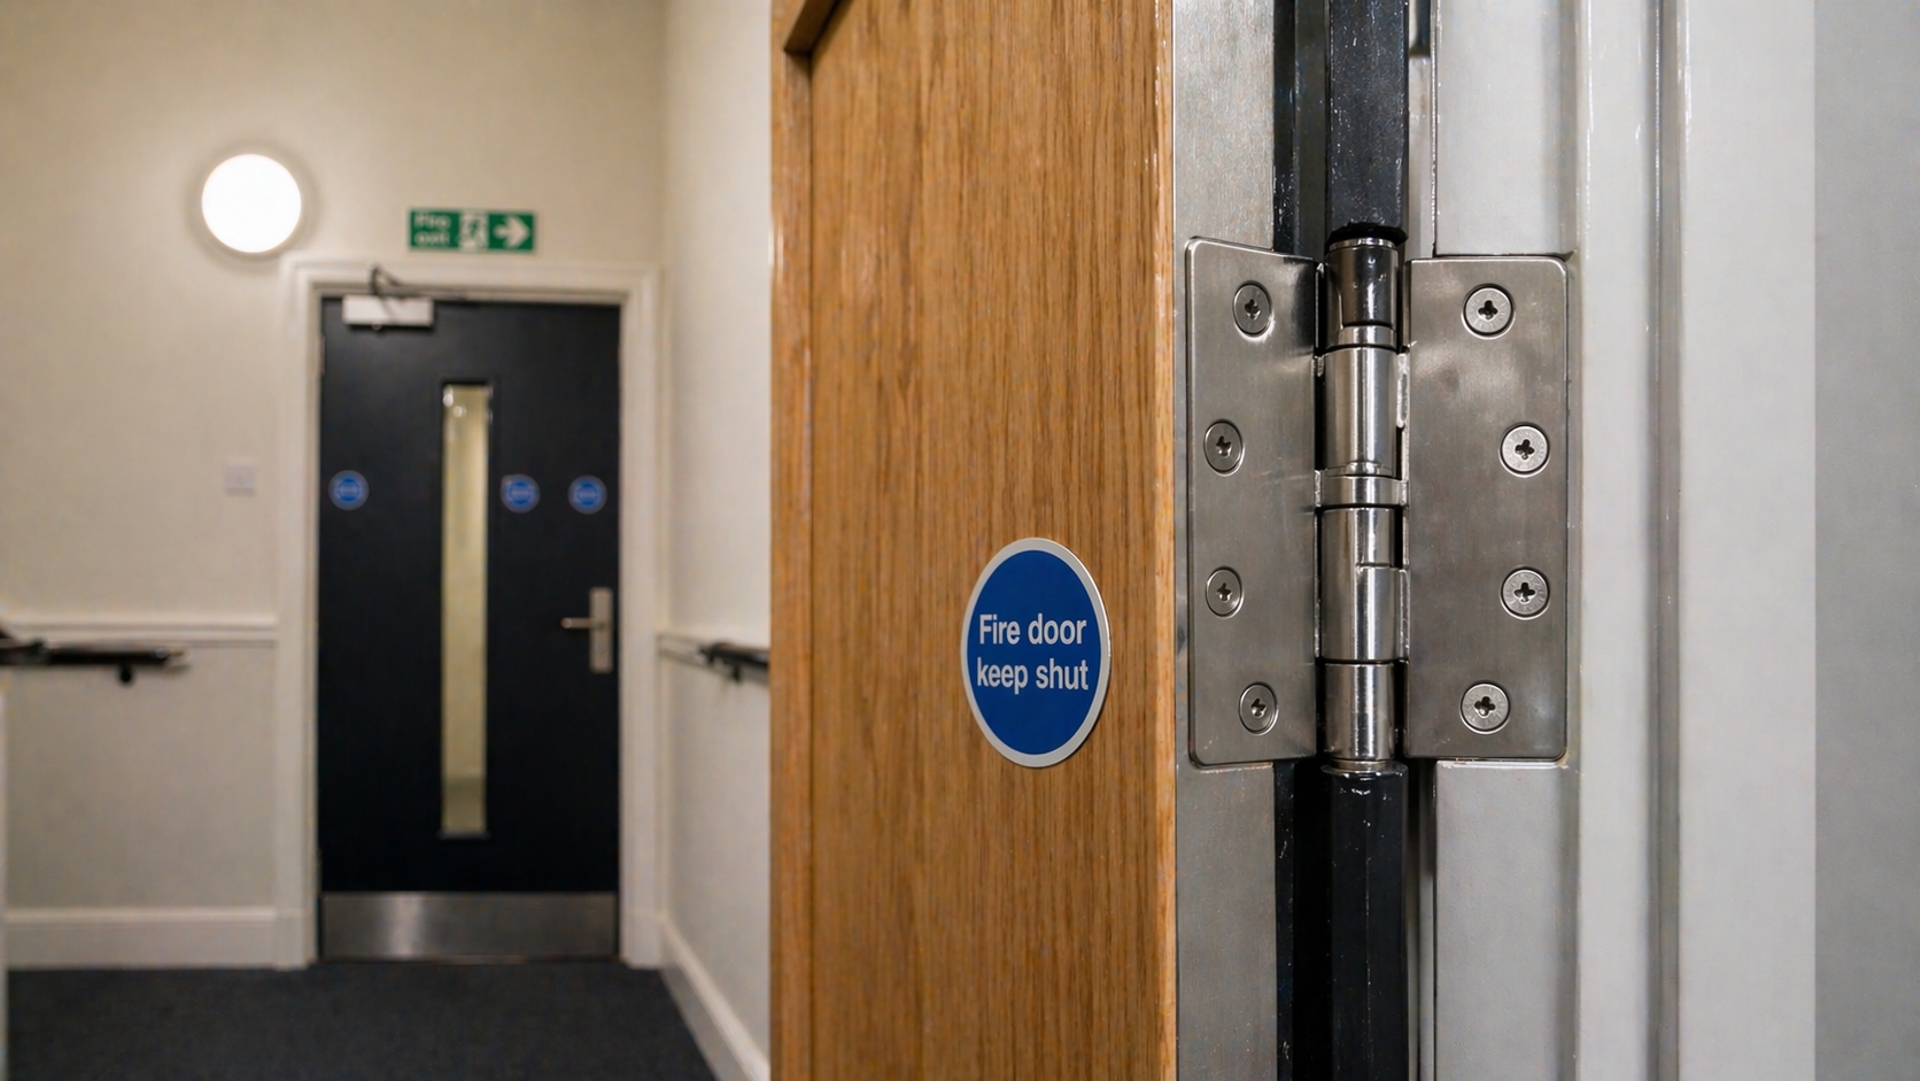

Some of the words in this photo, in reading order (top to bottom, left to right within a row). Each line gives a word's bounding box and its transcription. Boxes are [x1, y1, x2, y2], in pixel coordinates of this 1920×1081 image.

[979, 614, 1021, 645] Fire
[1028, 613, 1087, 645] door
[977, 657, 1029, 695] keep
[1035, 658, 1089, 690] shut
